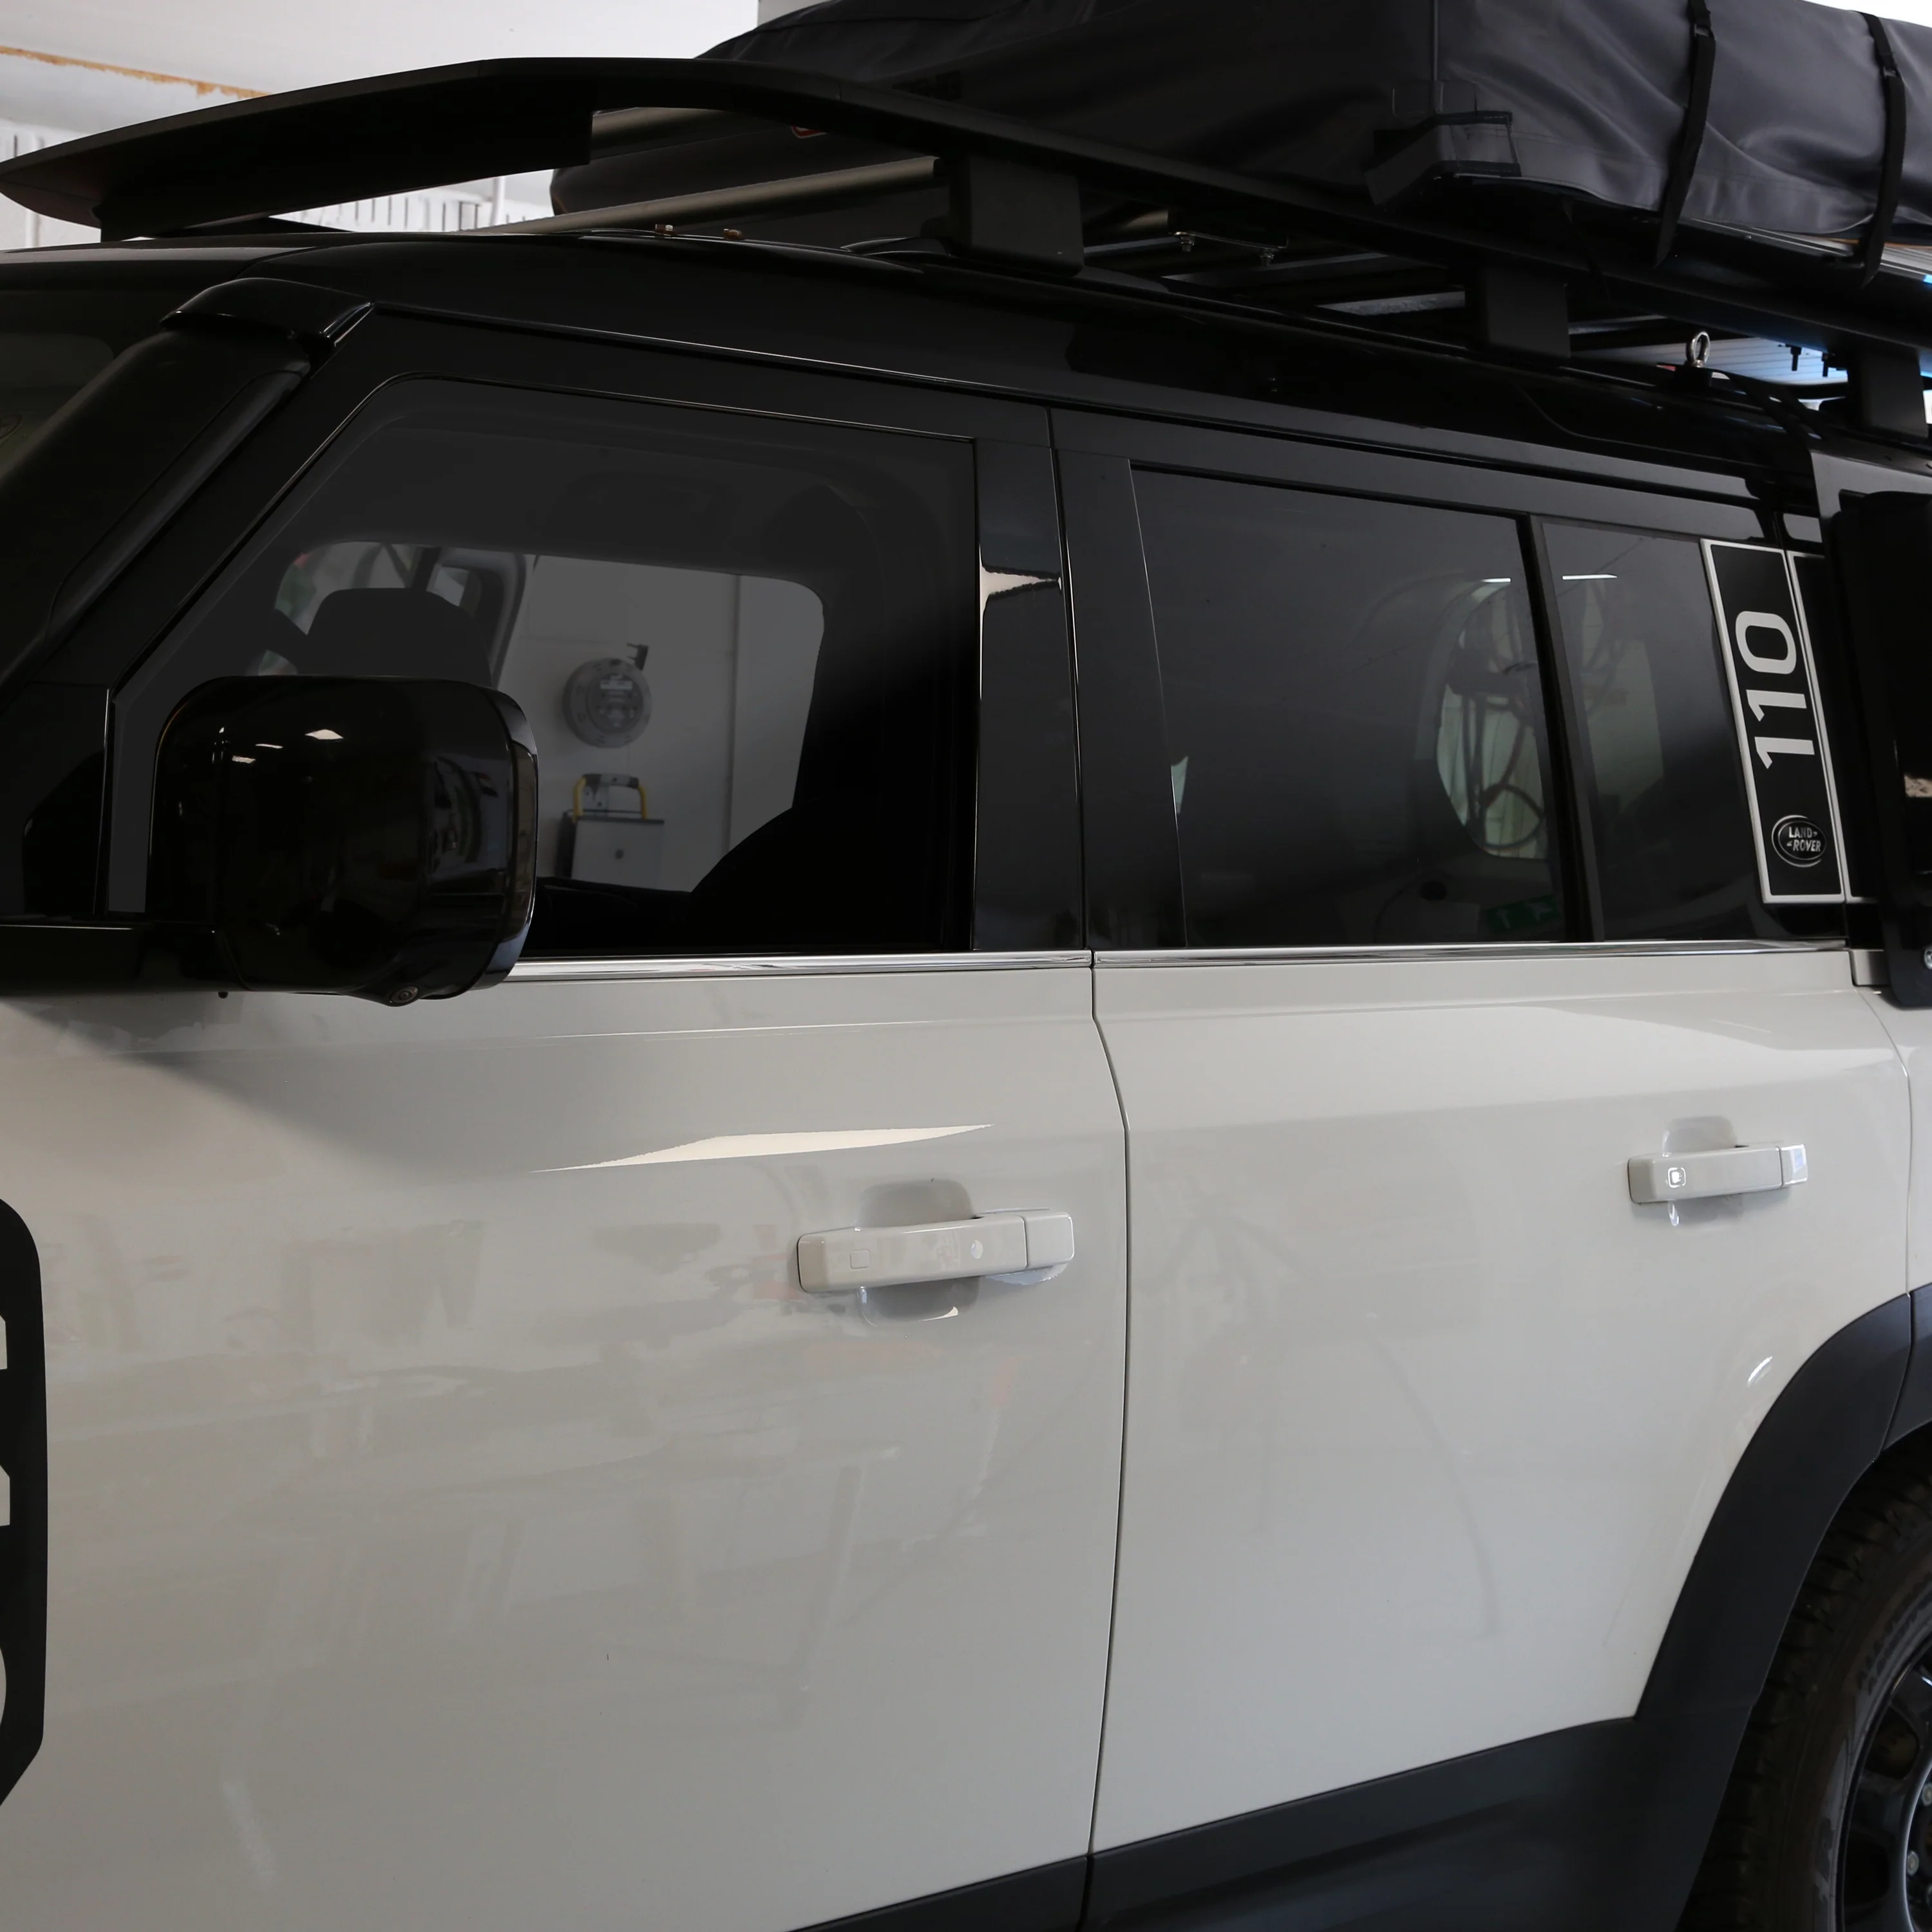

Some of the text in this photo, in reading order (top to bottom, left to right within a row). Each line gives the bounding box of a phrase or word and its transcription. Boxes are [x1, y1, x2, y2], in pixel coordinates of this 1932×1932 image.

[1735, 611, 1815, 769] 110
[1788, 826, 1813, 838] LAND
[1792, 839, 1821, 852] ROVER
